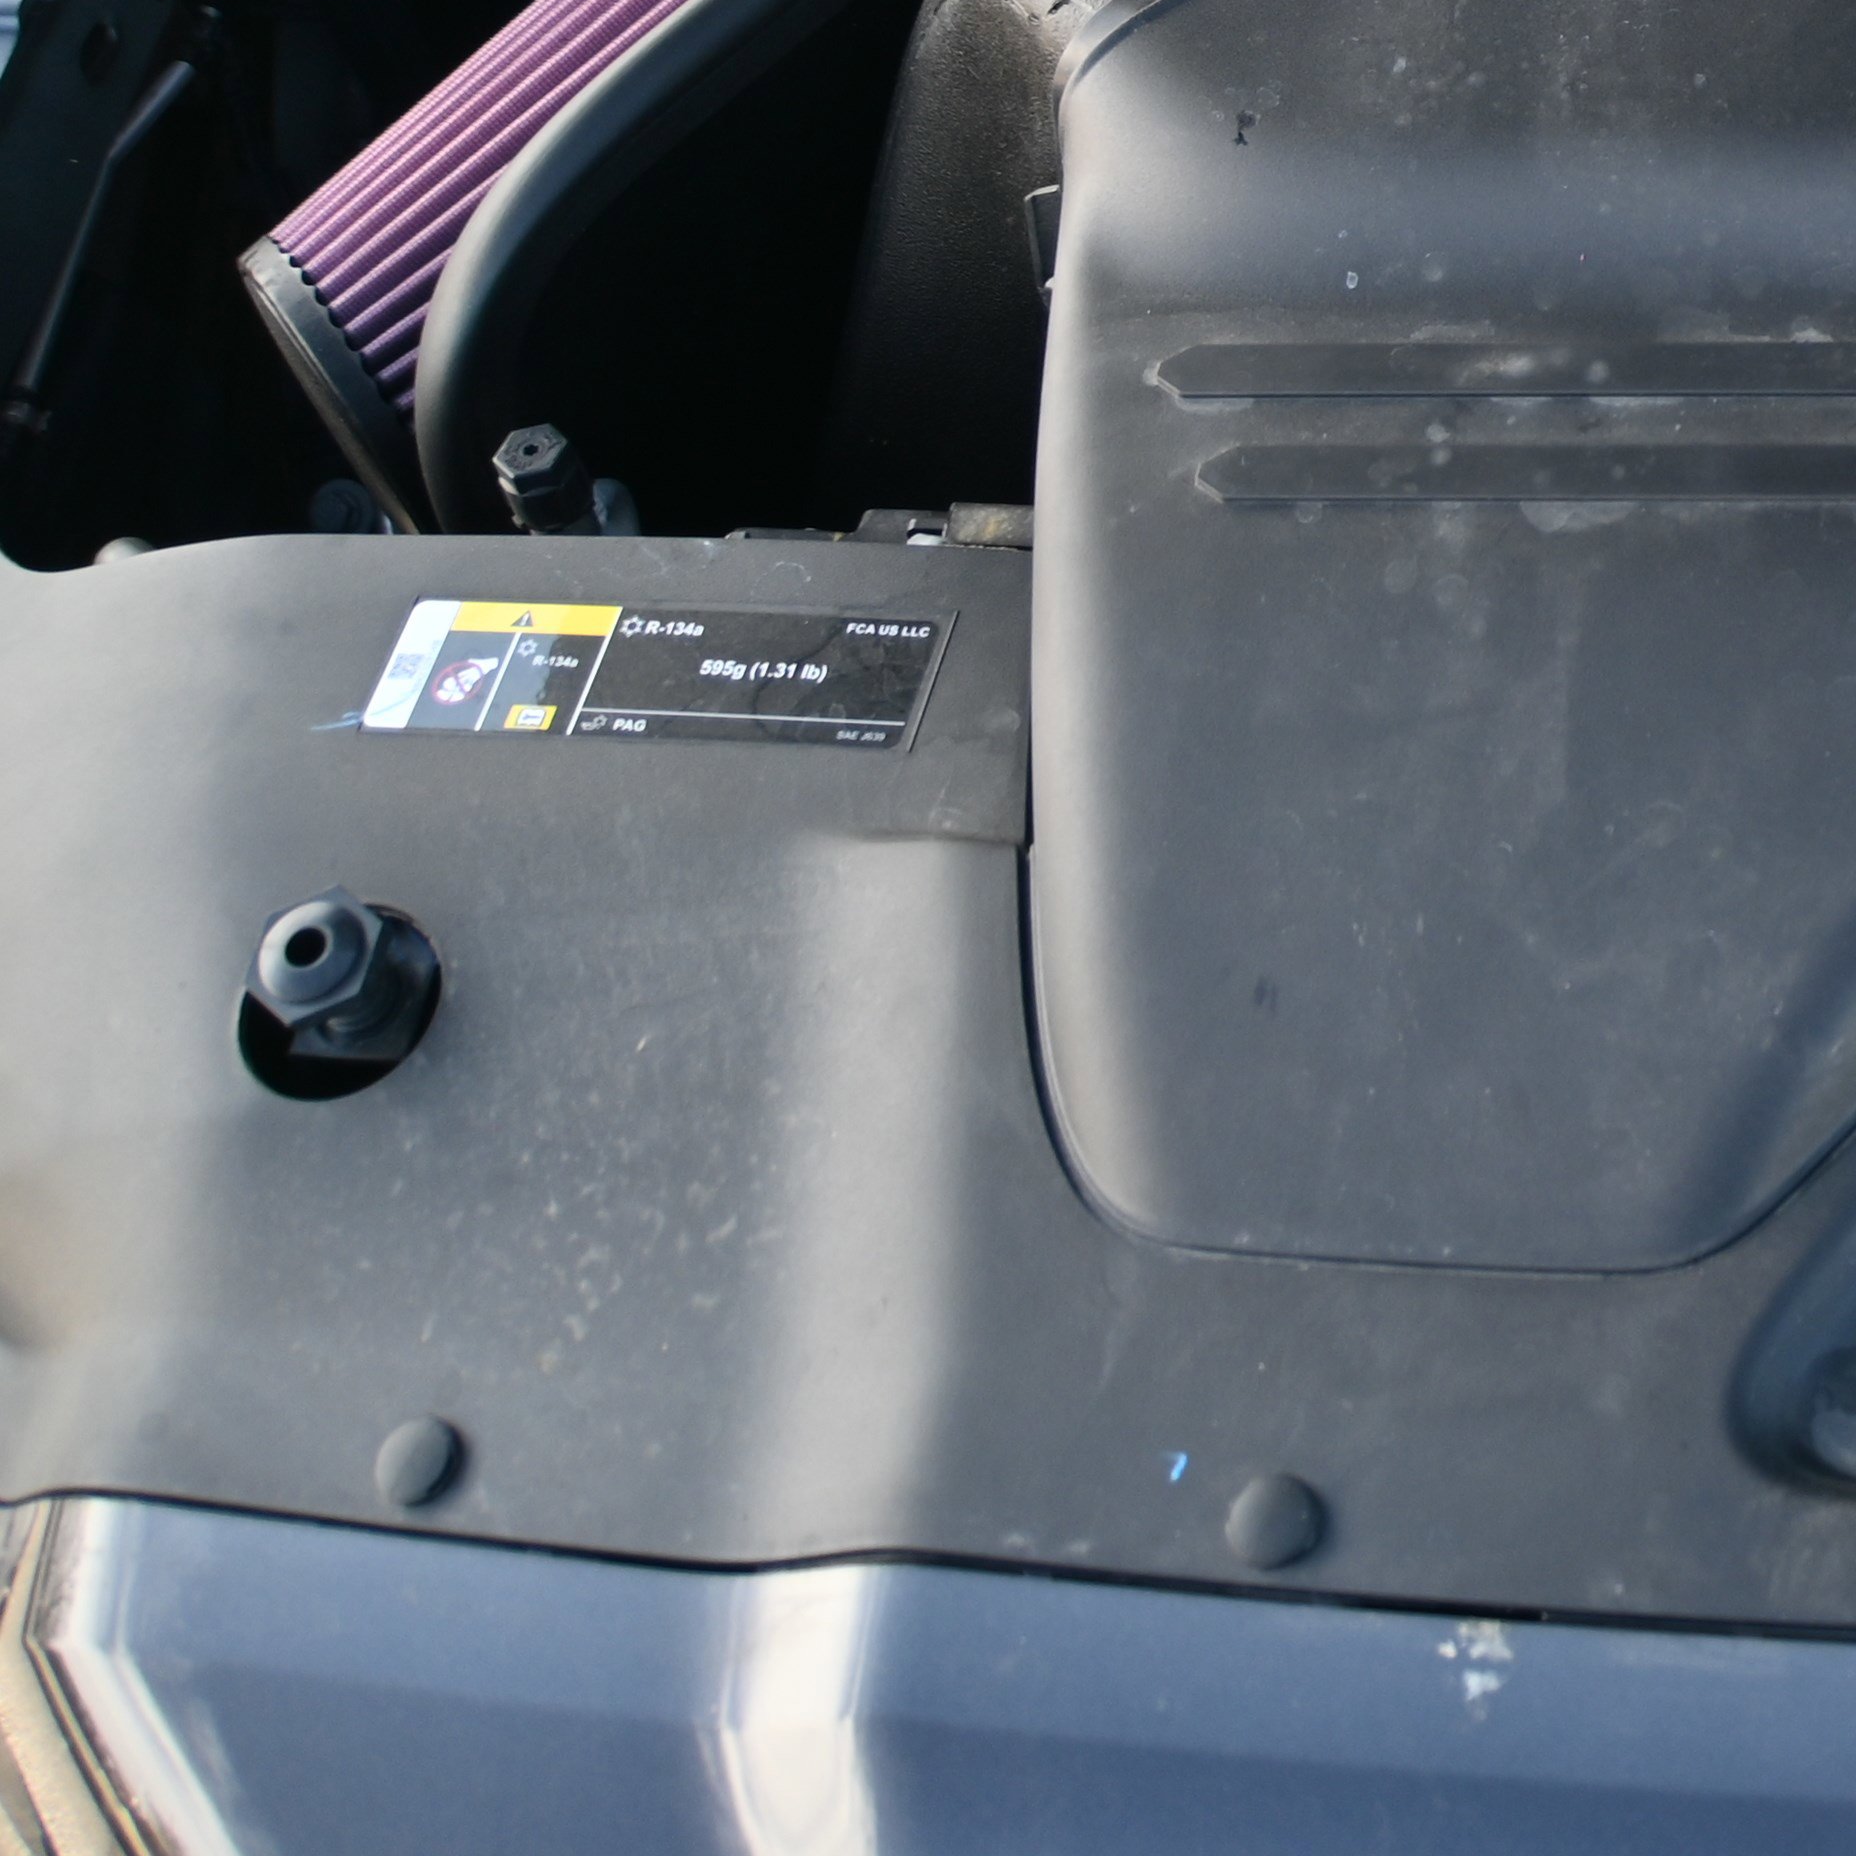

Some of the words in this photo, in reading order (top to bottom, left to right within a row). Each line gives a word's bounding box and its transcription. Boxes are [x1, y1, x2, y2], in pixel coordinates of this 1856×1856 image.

[643, 620, 705, 637] R-134a
[846, 622, 875, 635] FCA
[878, 624, 899, 637] US
[901, 625, 931, 638] LLC
[532, 655, 579, 668] R-134a
[699, 659, 747, 680] 595g
[749, 661, 797, 681] (1.31
[800, 663, 828, 683] lb)
[612, 718, 647, 732] PAG
